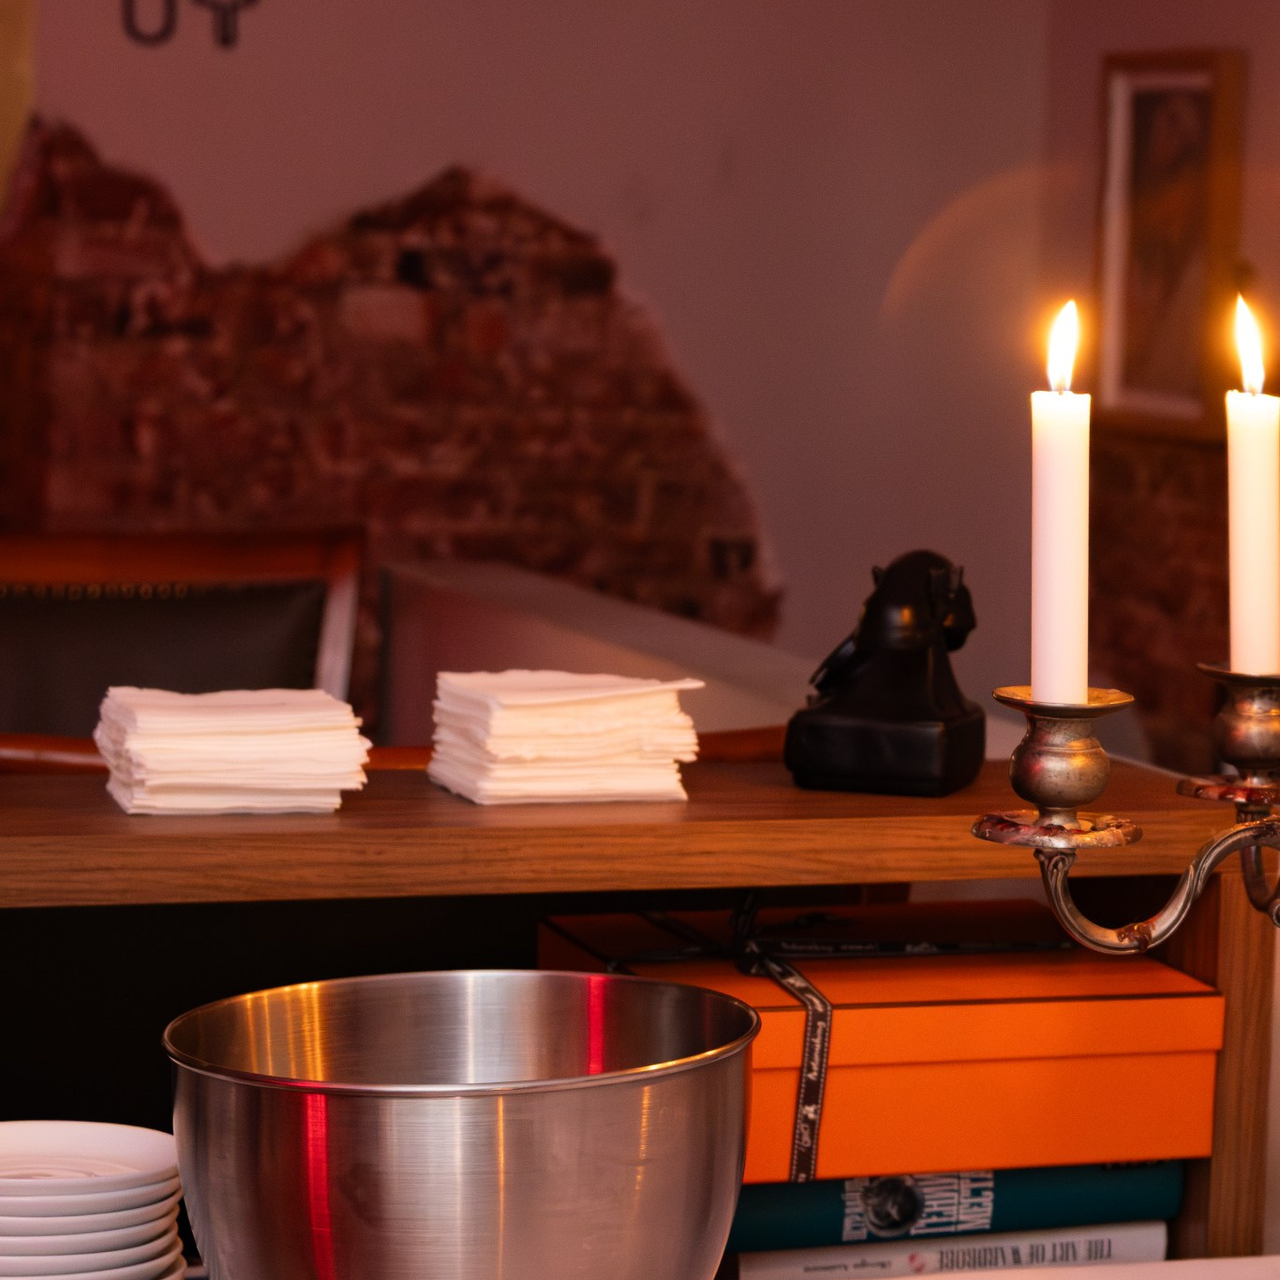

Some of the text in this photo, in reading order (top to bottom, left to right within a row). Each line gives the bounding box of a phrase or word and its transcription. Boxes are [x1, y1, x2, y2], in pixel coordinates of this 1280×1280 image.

[1028, 1244, 1045, 1265] OF
[1050, 1241, 1077, 1263] ART
[1087, 1238, 1112, 1260] THE
